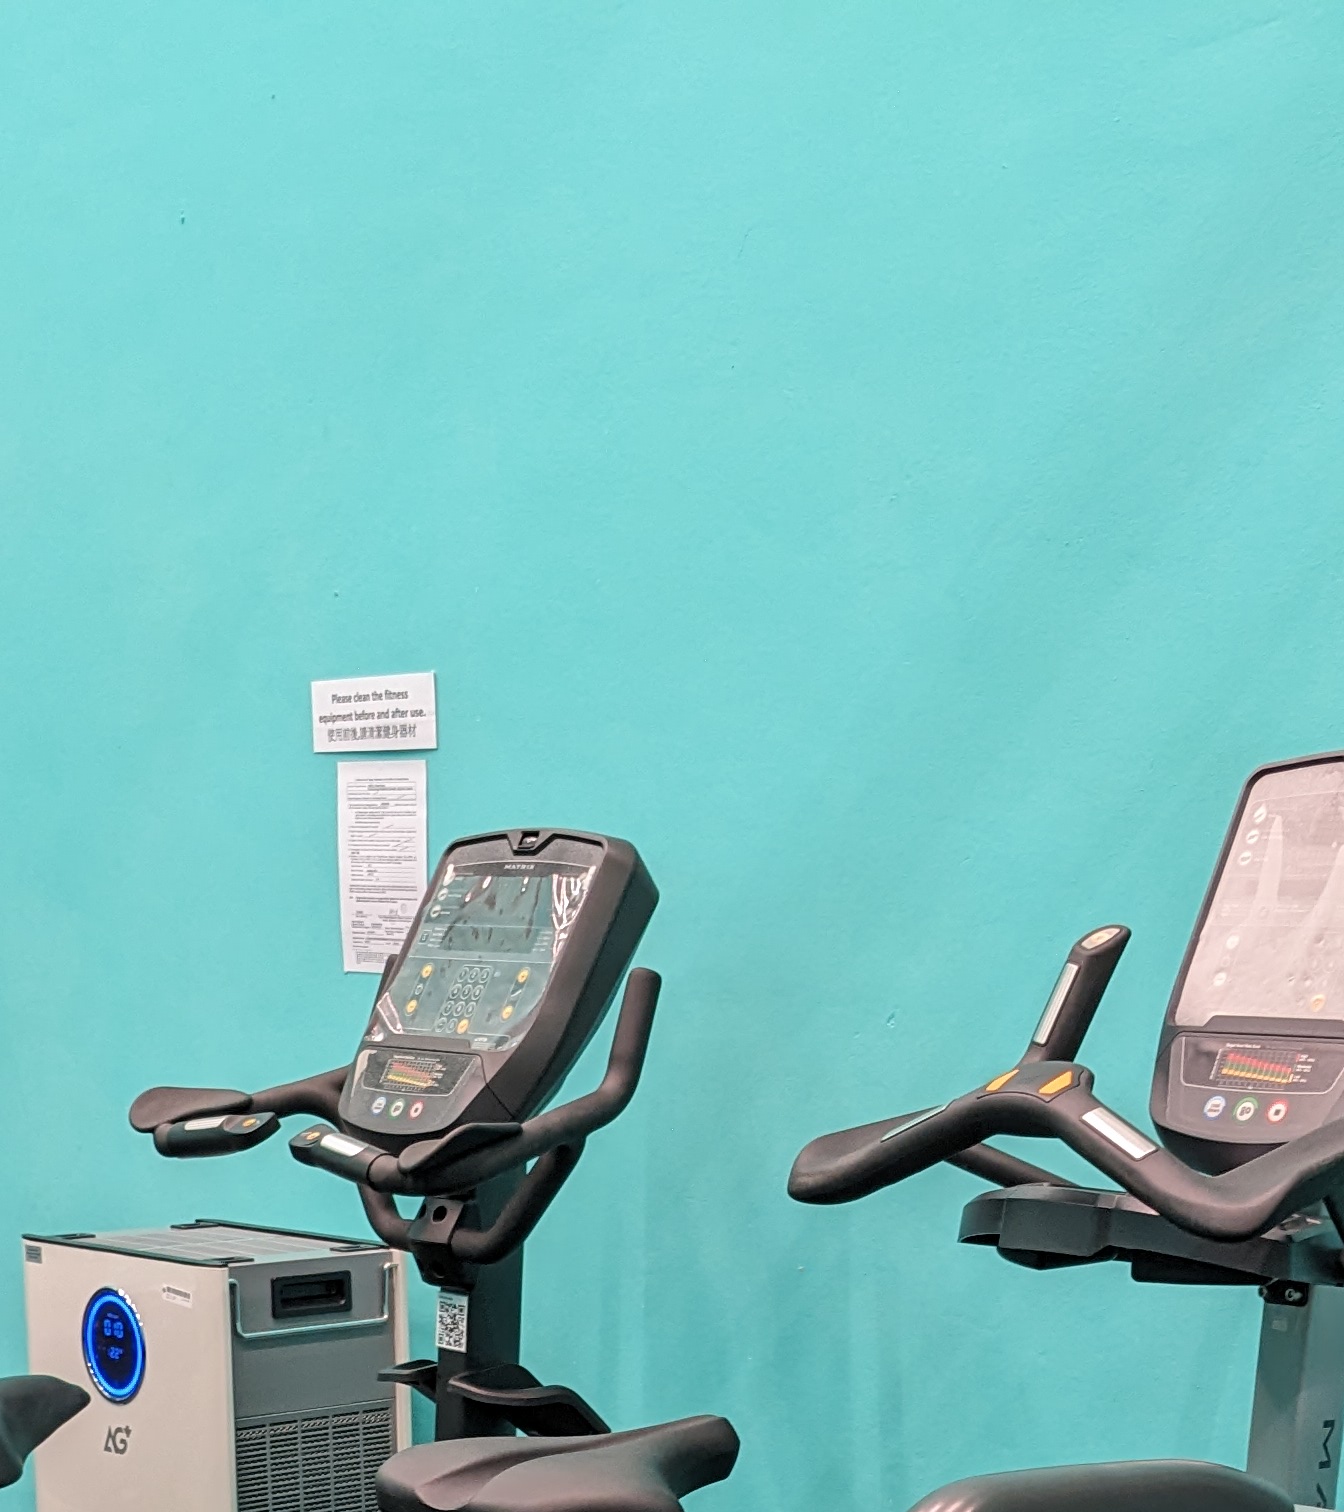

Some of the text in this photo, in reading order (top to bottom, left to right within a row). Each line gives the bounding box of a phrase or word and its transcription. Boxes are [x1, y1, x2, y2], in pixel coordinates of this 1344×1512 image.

[331, 689, 409, 704] Please clean the fitness
[319, 708, 426, 724] equipment before and after use.
